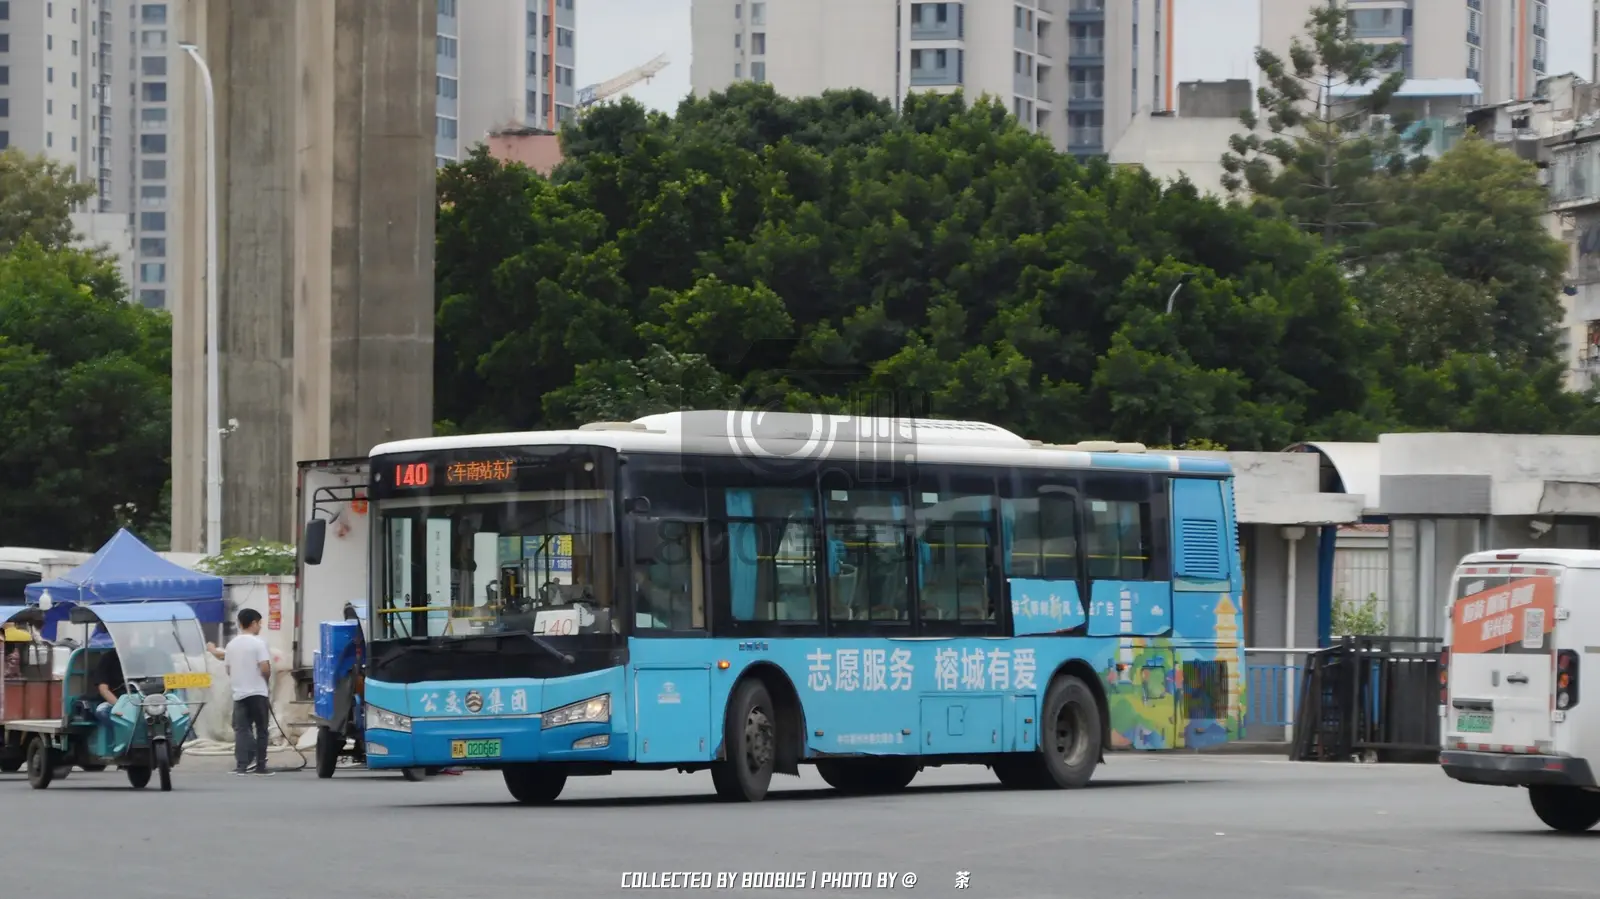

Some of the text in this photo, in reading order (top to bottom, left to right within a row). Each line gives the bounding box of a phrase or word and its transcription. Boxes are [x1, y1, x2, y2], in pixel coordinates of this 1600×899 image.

[396, 463, 428, 486] 140
[540, 619, 573, 635] 140
[806, 648, 1038, 692] 志愿服务 榕城有爱
